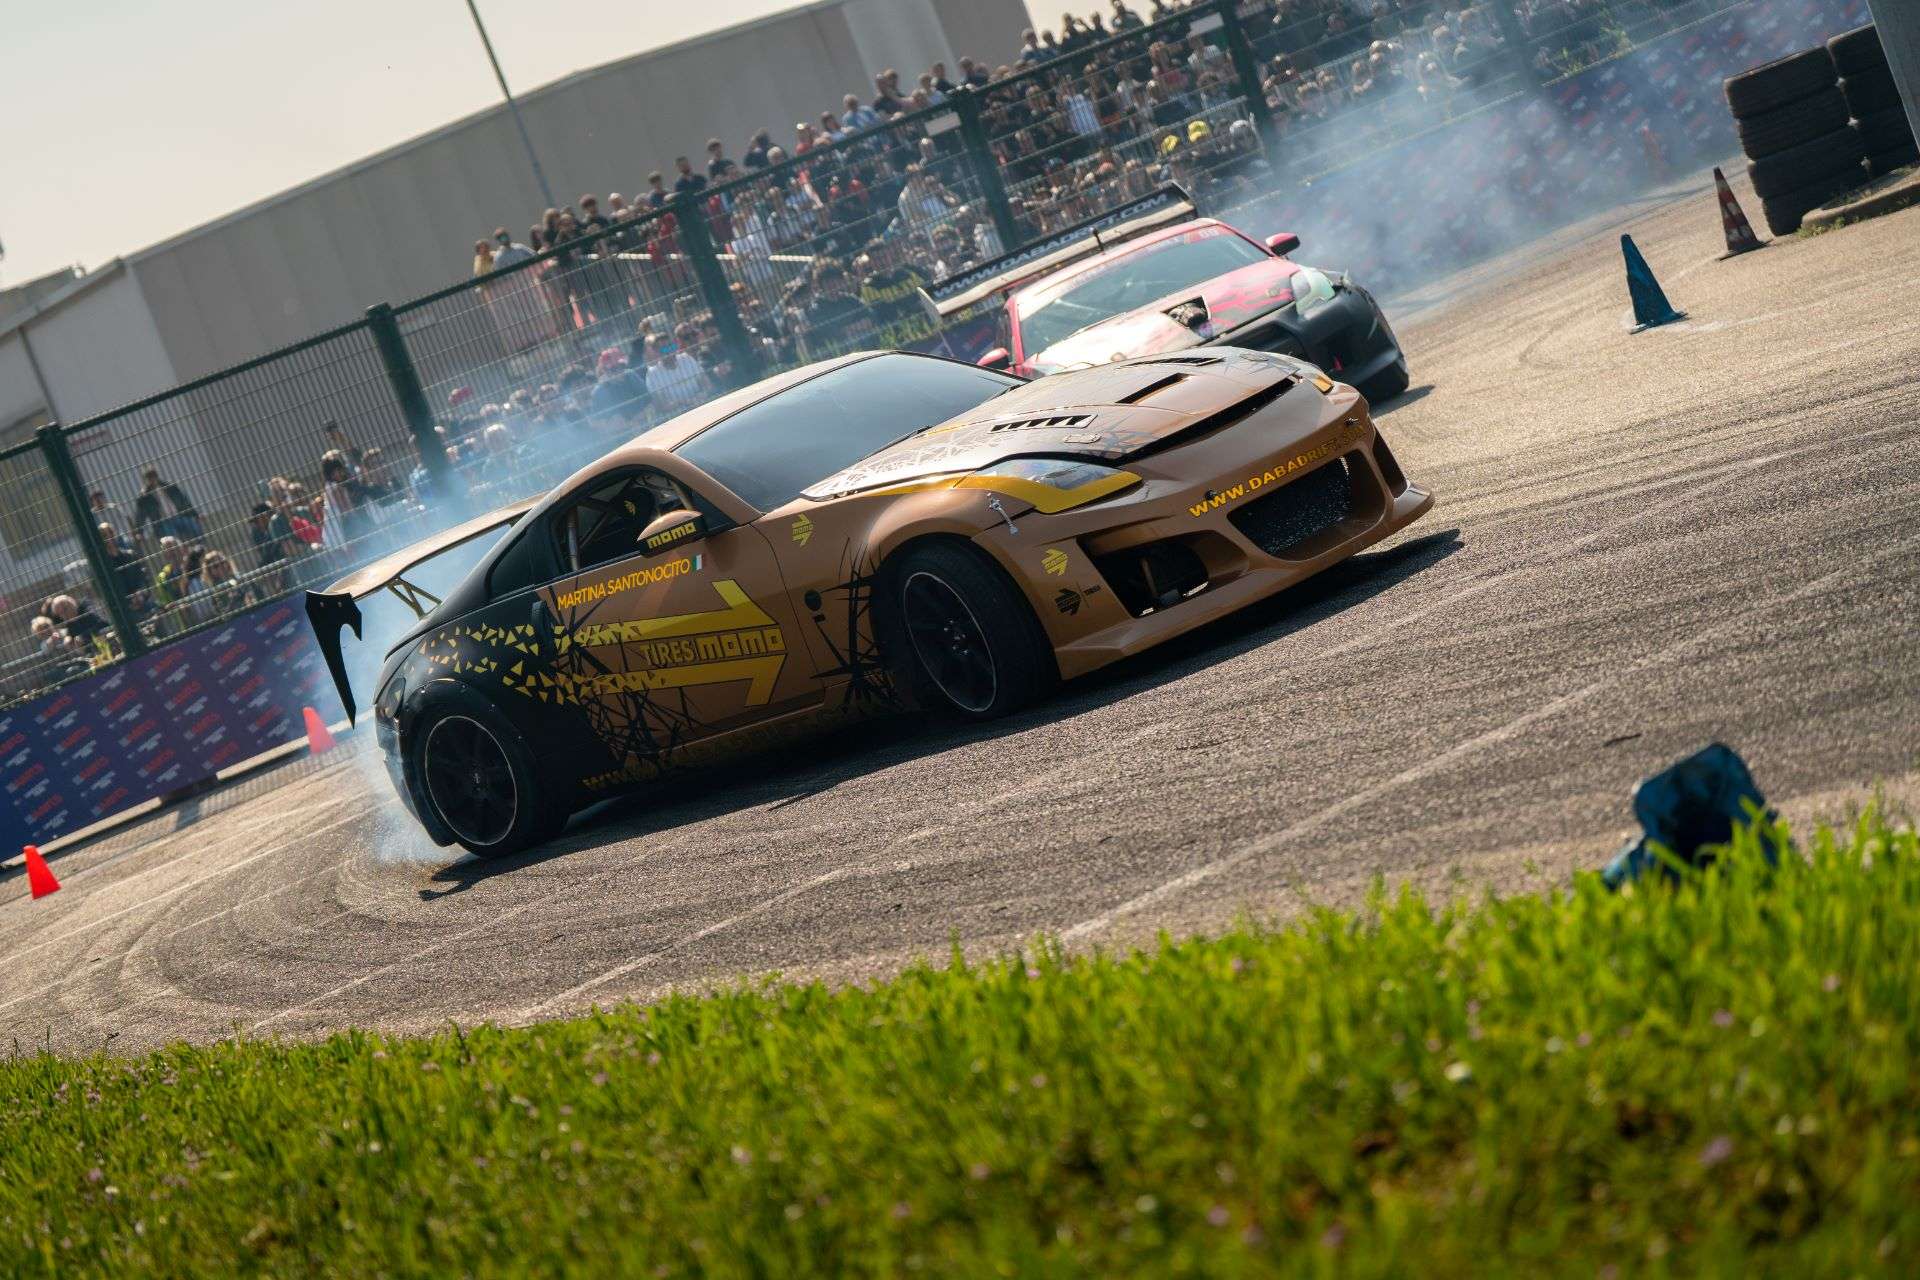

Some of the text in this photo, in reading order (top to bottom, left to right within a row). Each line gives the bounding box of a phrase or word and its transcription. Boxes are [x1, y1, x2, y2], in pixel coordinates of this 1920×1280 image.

[557, 558, 691, 611] MARTINA SANTONOCITO
[639, 638, 695, 666] TIRES
